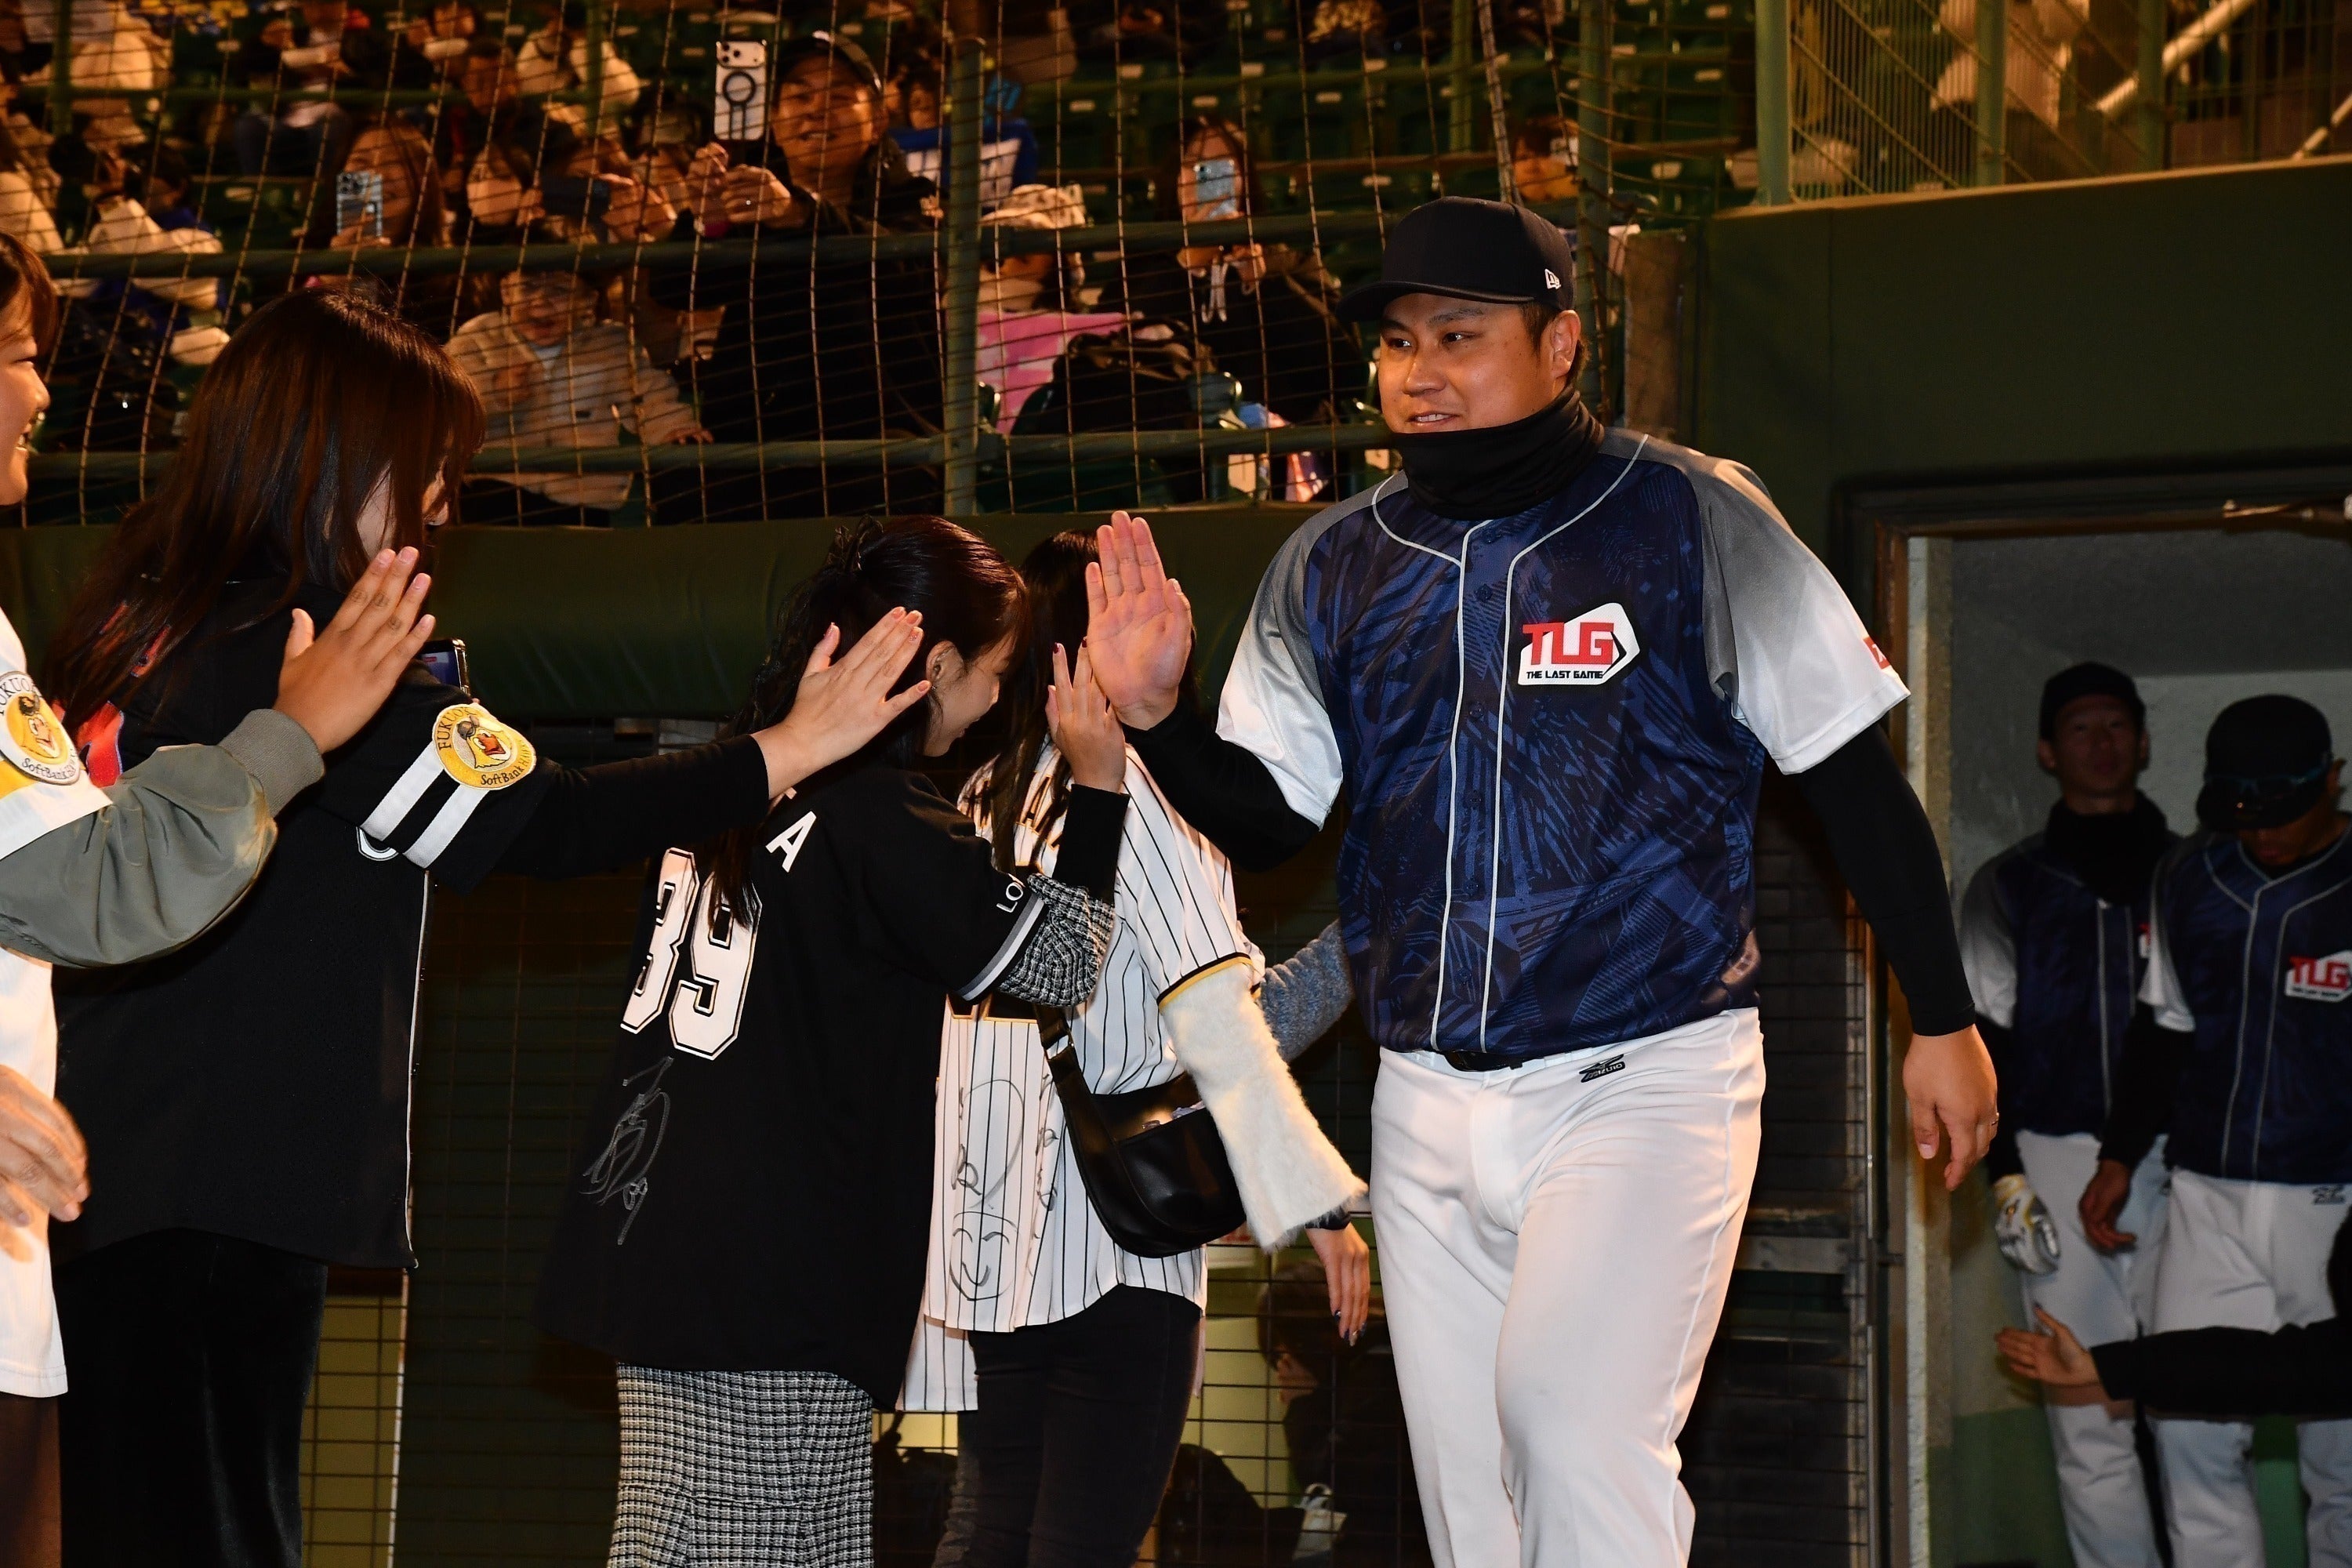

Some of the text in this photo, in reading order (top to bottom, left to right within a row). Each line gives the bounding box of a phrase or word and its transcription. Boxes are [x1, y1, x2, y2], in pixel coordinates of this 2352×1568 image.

[1522, 622, 1614, 666] TLG
[1526, 670, 1603, 680] THE LAST GAME
[479, 765, 524, 786] SoftBank
[765, 786, 817, 873] A
[996, 873, 1025, 913] LO
[620, 847, 763, 1061] 39
[2289, 956, 2349, 991] TLG
